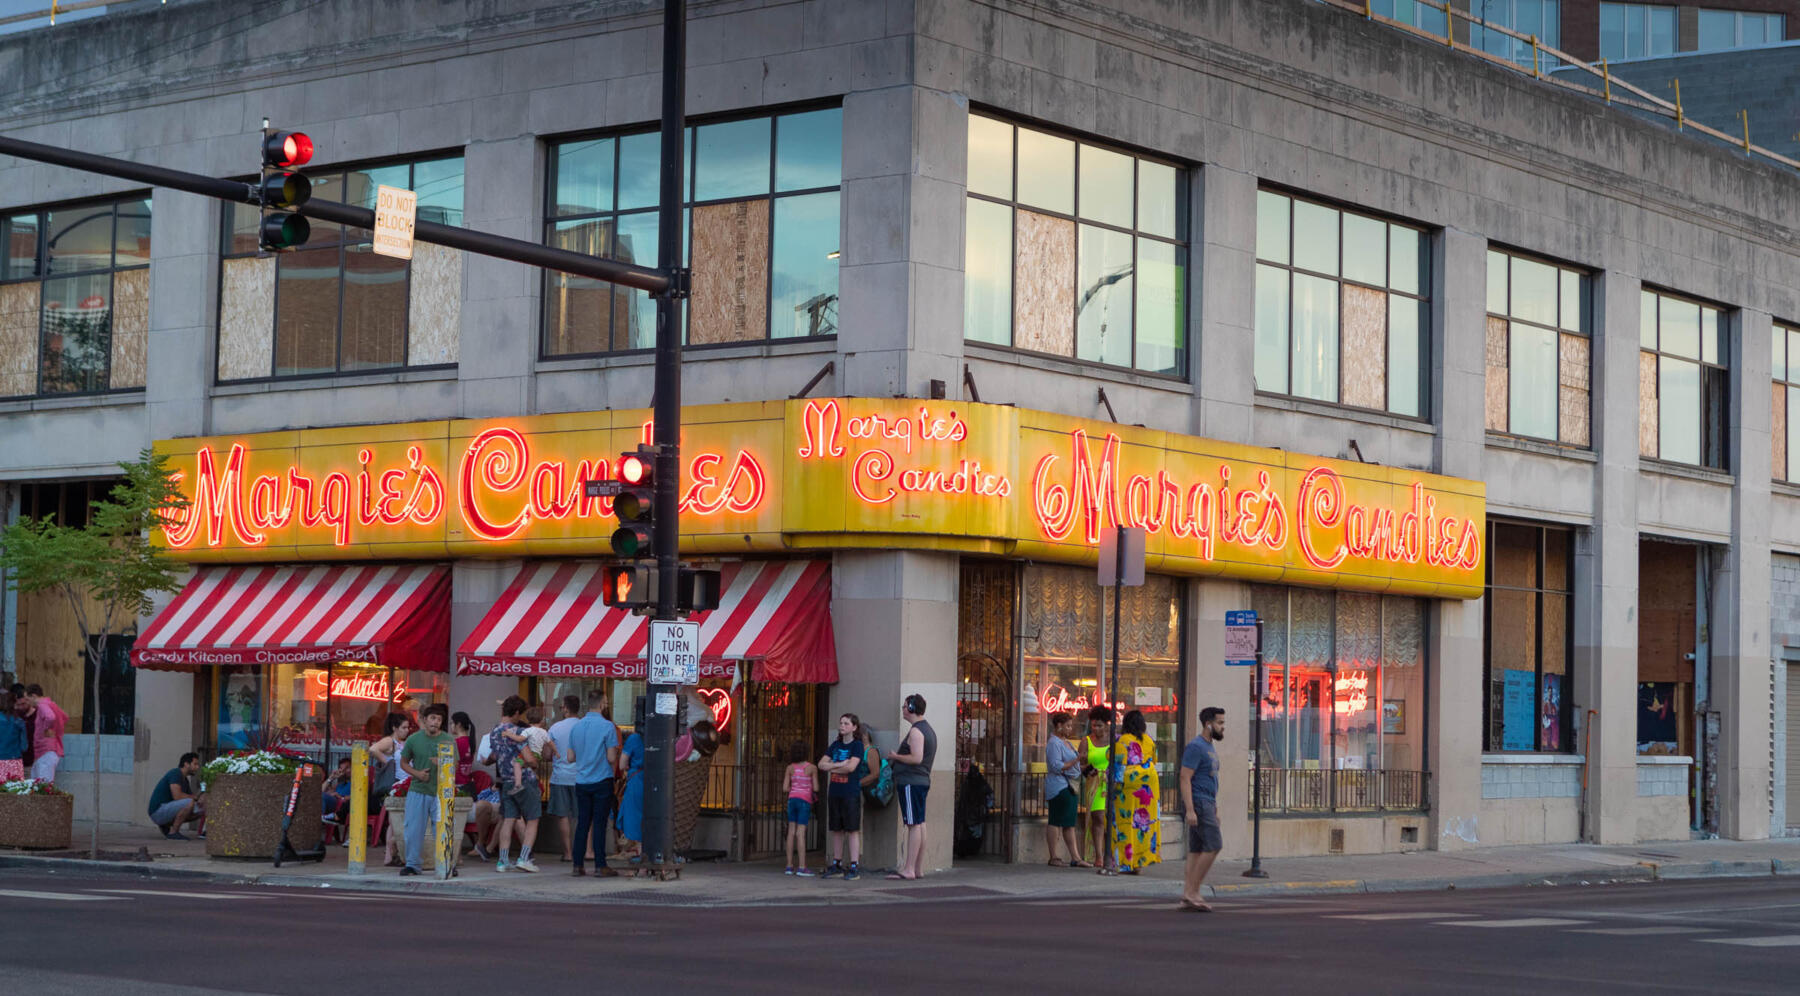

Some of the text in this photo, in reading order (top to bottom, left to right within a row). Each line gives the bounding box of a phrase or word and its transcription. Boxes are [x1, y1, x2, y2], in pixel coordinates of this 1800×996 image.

[380, 193, 413, 212] DO NOT
[378, 212, 412, 232] BLOCK
[798, 399, 967, 458] Margie's
[160, 421, 766, 546] Margie's Canes
[852, 449, 1012, 503] Candies
[1034, 428, 1481, 570] Margie's Candies
[667, 626, 684, 638] NO
[662, 640, 689, 652] TURN
[139, 651, 184, 664] Candy
[188, 651, 242, 663] Kitchen
[255, 650, 330, 663] Chocolate
[655, 653, 695, 666] ON RED
[468, 659, 532, 673] Shakes
[538, 660, 606, 674] Banana
[611, 662, 647, 677] Spli
